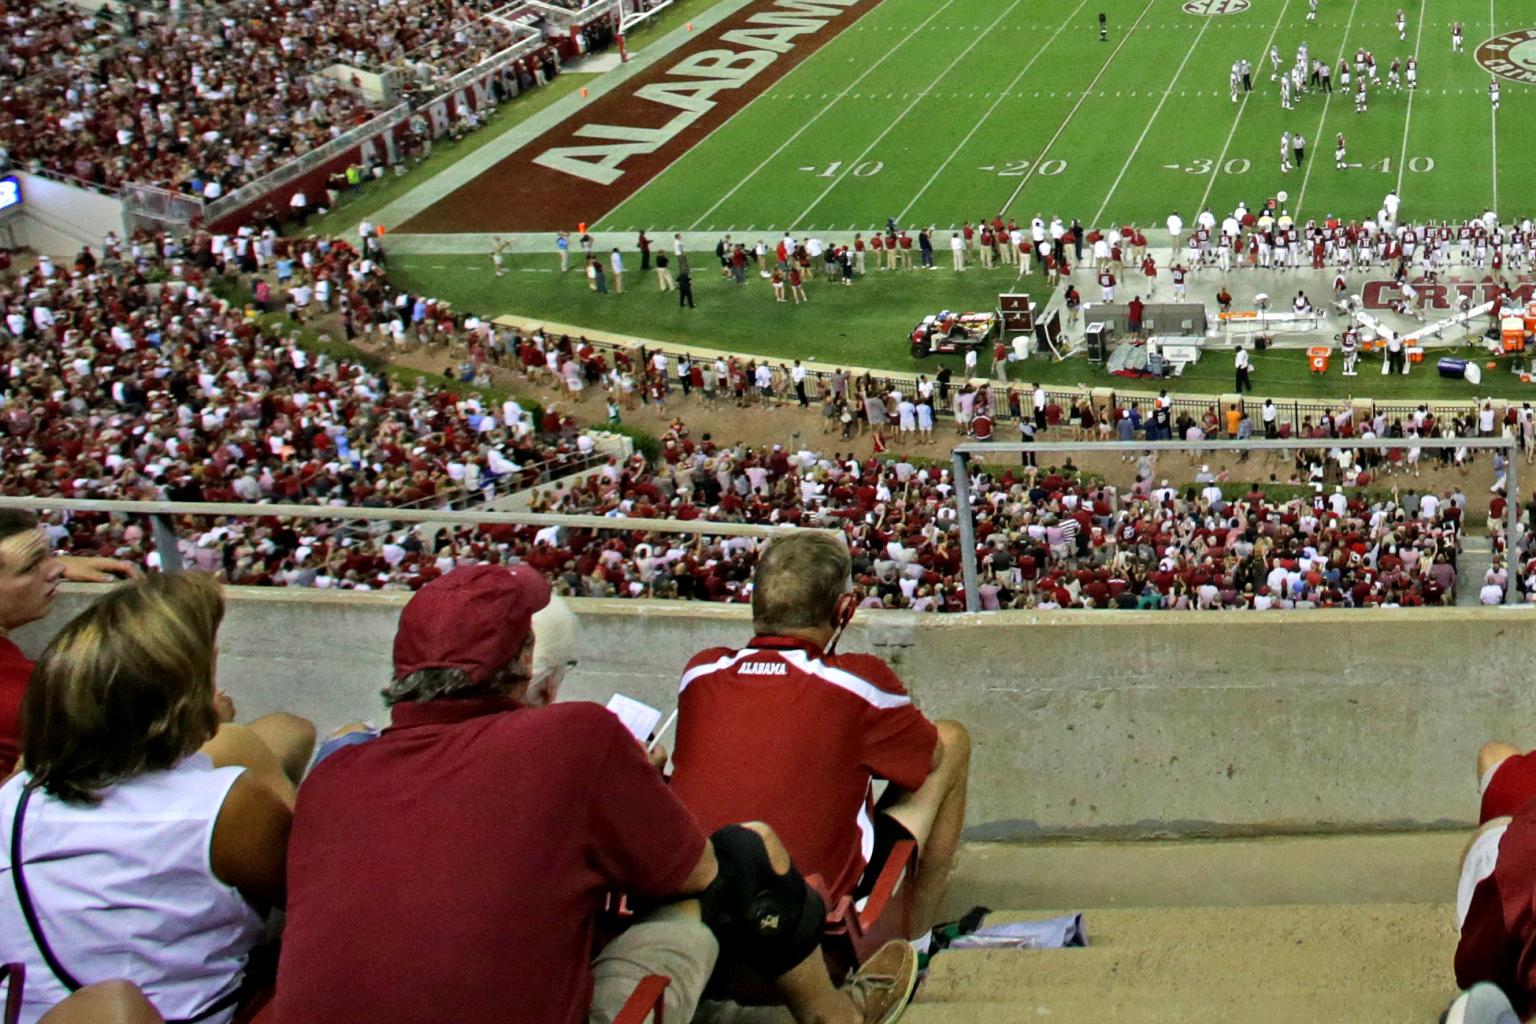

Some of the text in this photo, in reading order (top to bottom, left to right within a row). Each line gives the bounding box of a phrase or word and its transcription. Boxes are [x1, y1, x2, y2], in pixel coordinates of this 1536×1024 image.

[816, 161, 884, 178] 10
[997, 159, 1068, 177] 20
[1184, 158, 1252, 175] 30
[1369, 156, 1435, 174] 40
[737, 661, 788, 676] ALABAMA
